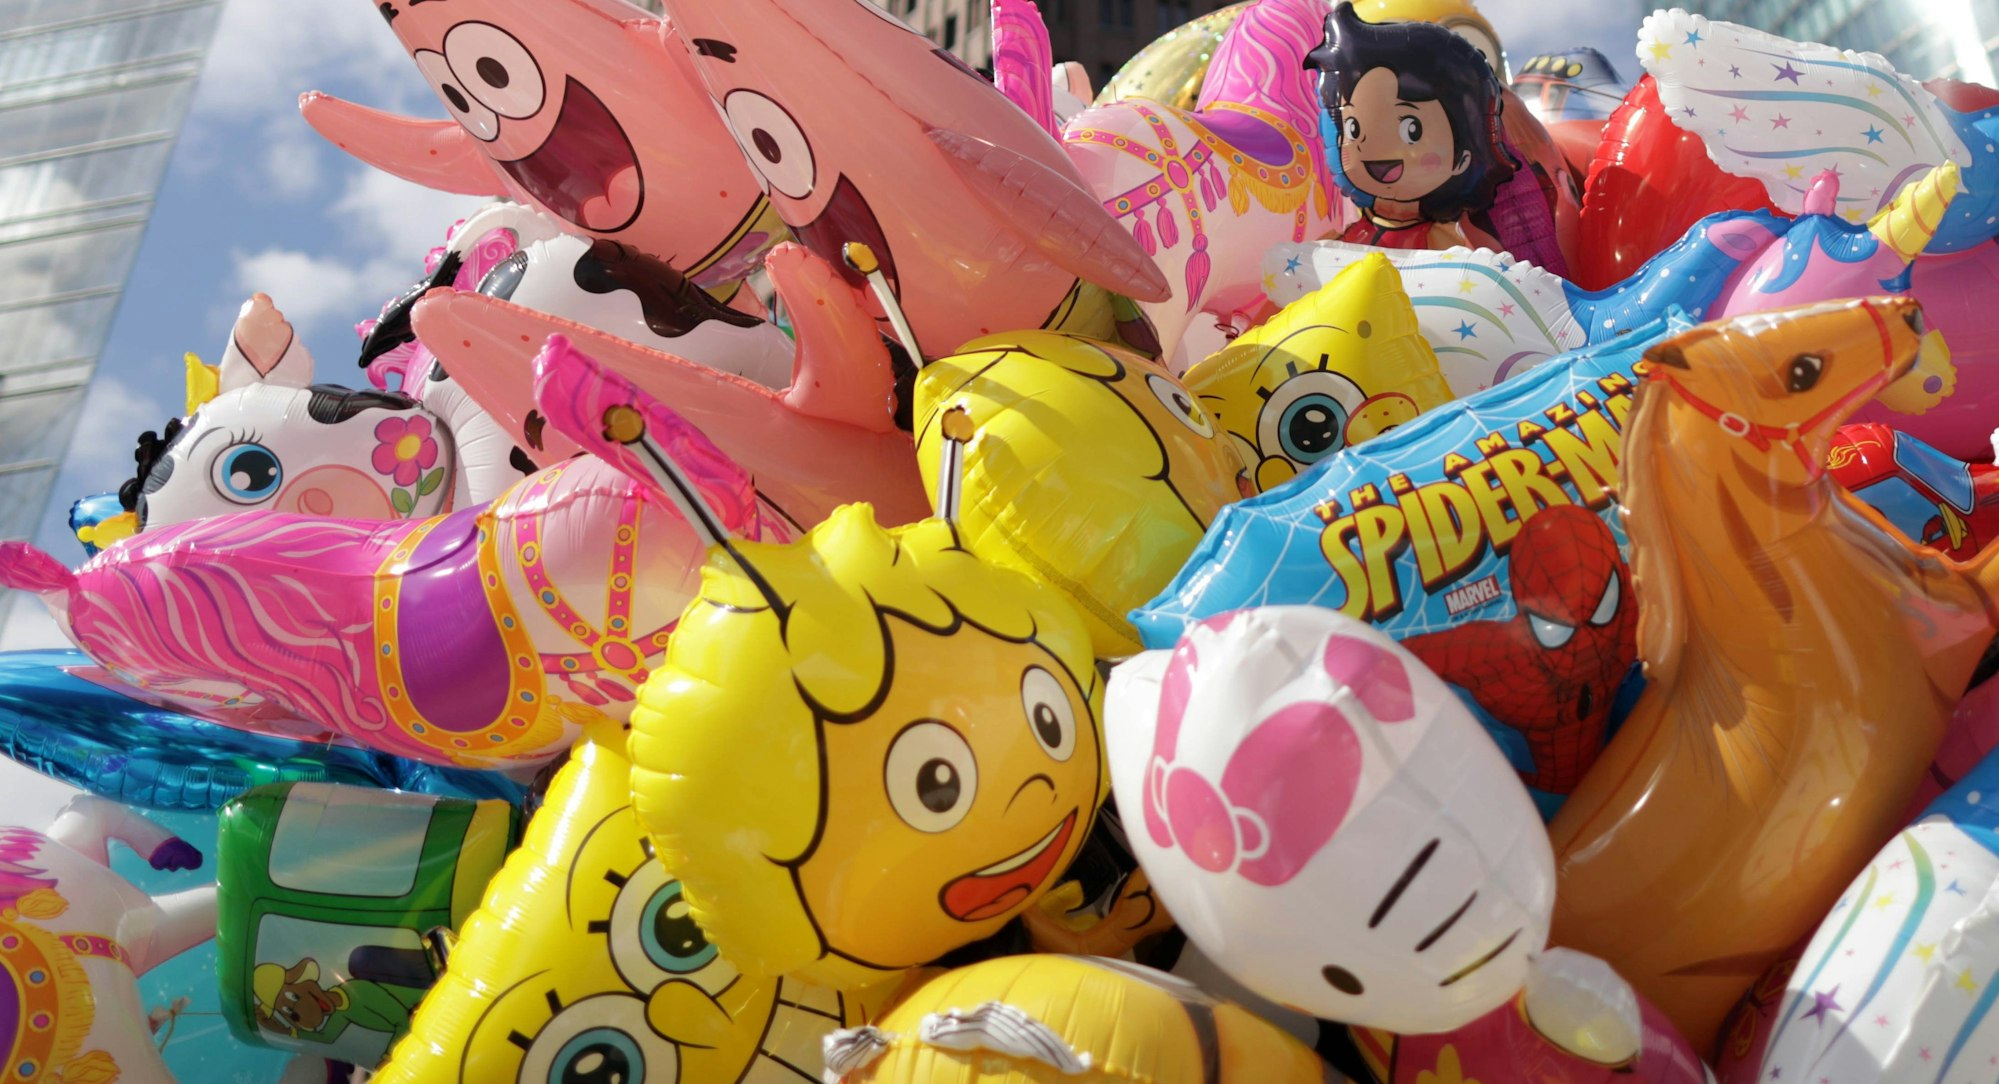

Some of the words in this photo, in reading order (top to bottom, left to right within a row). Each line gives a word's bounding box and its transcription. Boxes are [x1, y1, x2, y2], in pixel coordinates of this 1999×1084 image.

[1314, 472, 1414, 523] THE
[1320, 393, 1633, 623] SPIDER-M
[1444, 576, 1500, 615] MARVEL
